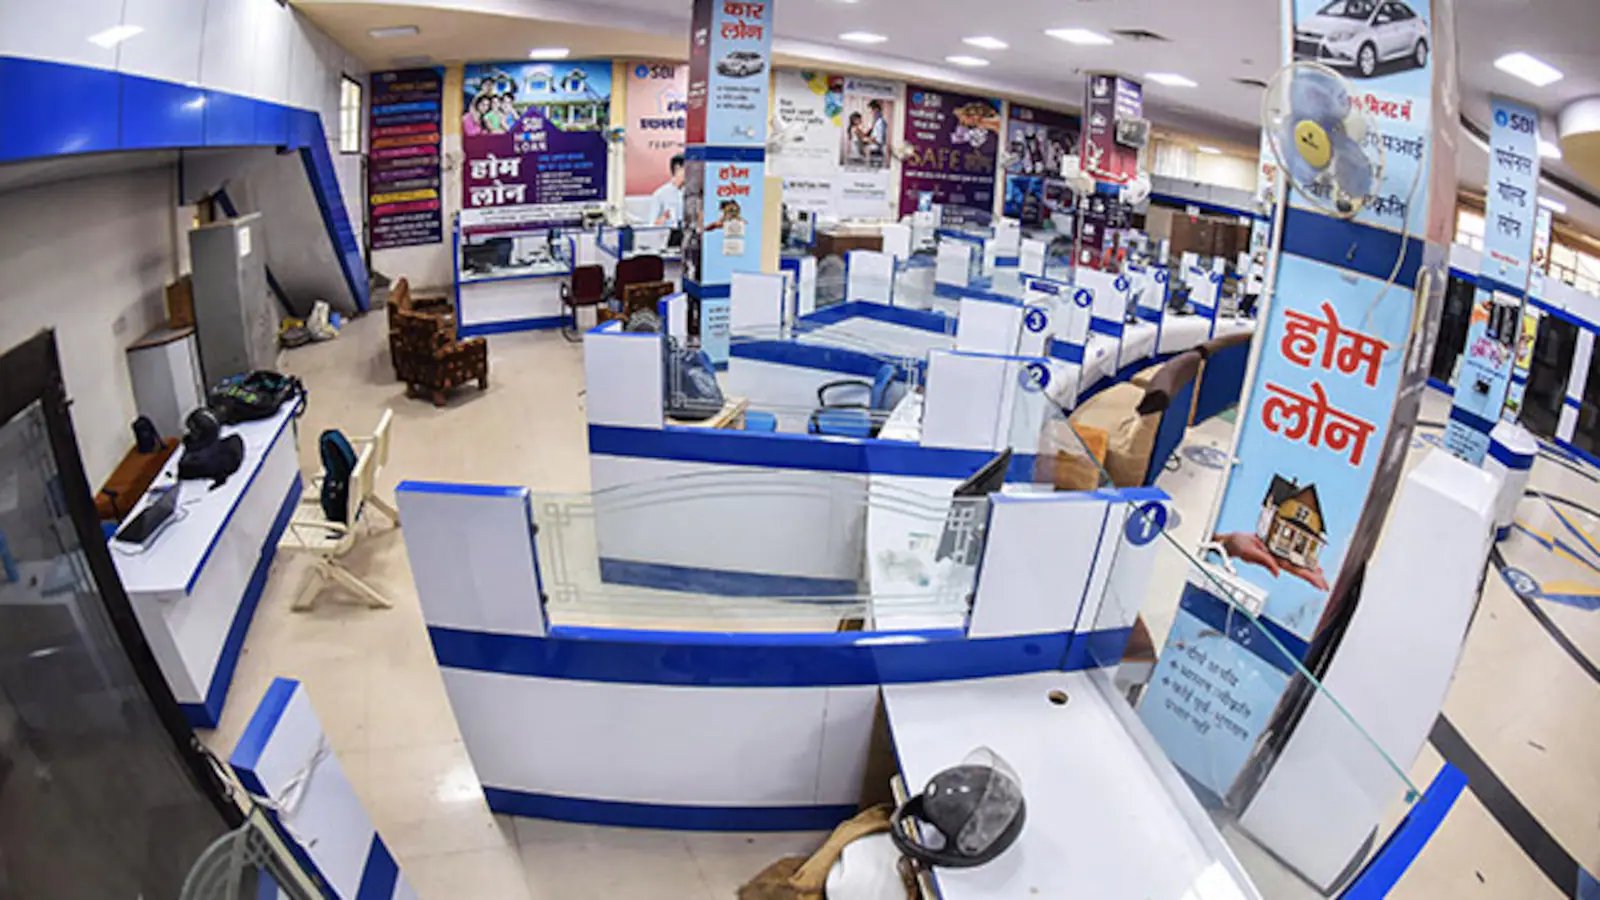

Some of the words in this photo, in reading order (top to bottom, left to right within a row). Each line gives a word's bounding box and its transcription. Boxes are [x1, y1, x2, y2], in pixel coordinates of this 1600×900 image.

[469, 153, 522, 179] होम
[718, 165, 750, 180] होम
[469, 179, 527, 206] लोन
[717, 182, 751, 197] लोन
[1280, 302, 1389, 388] होम
[1261, 381, 1377, 467] लोन
